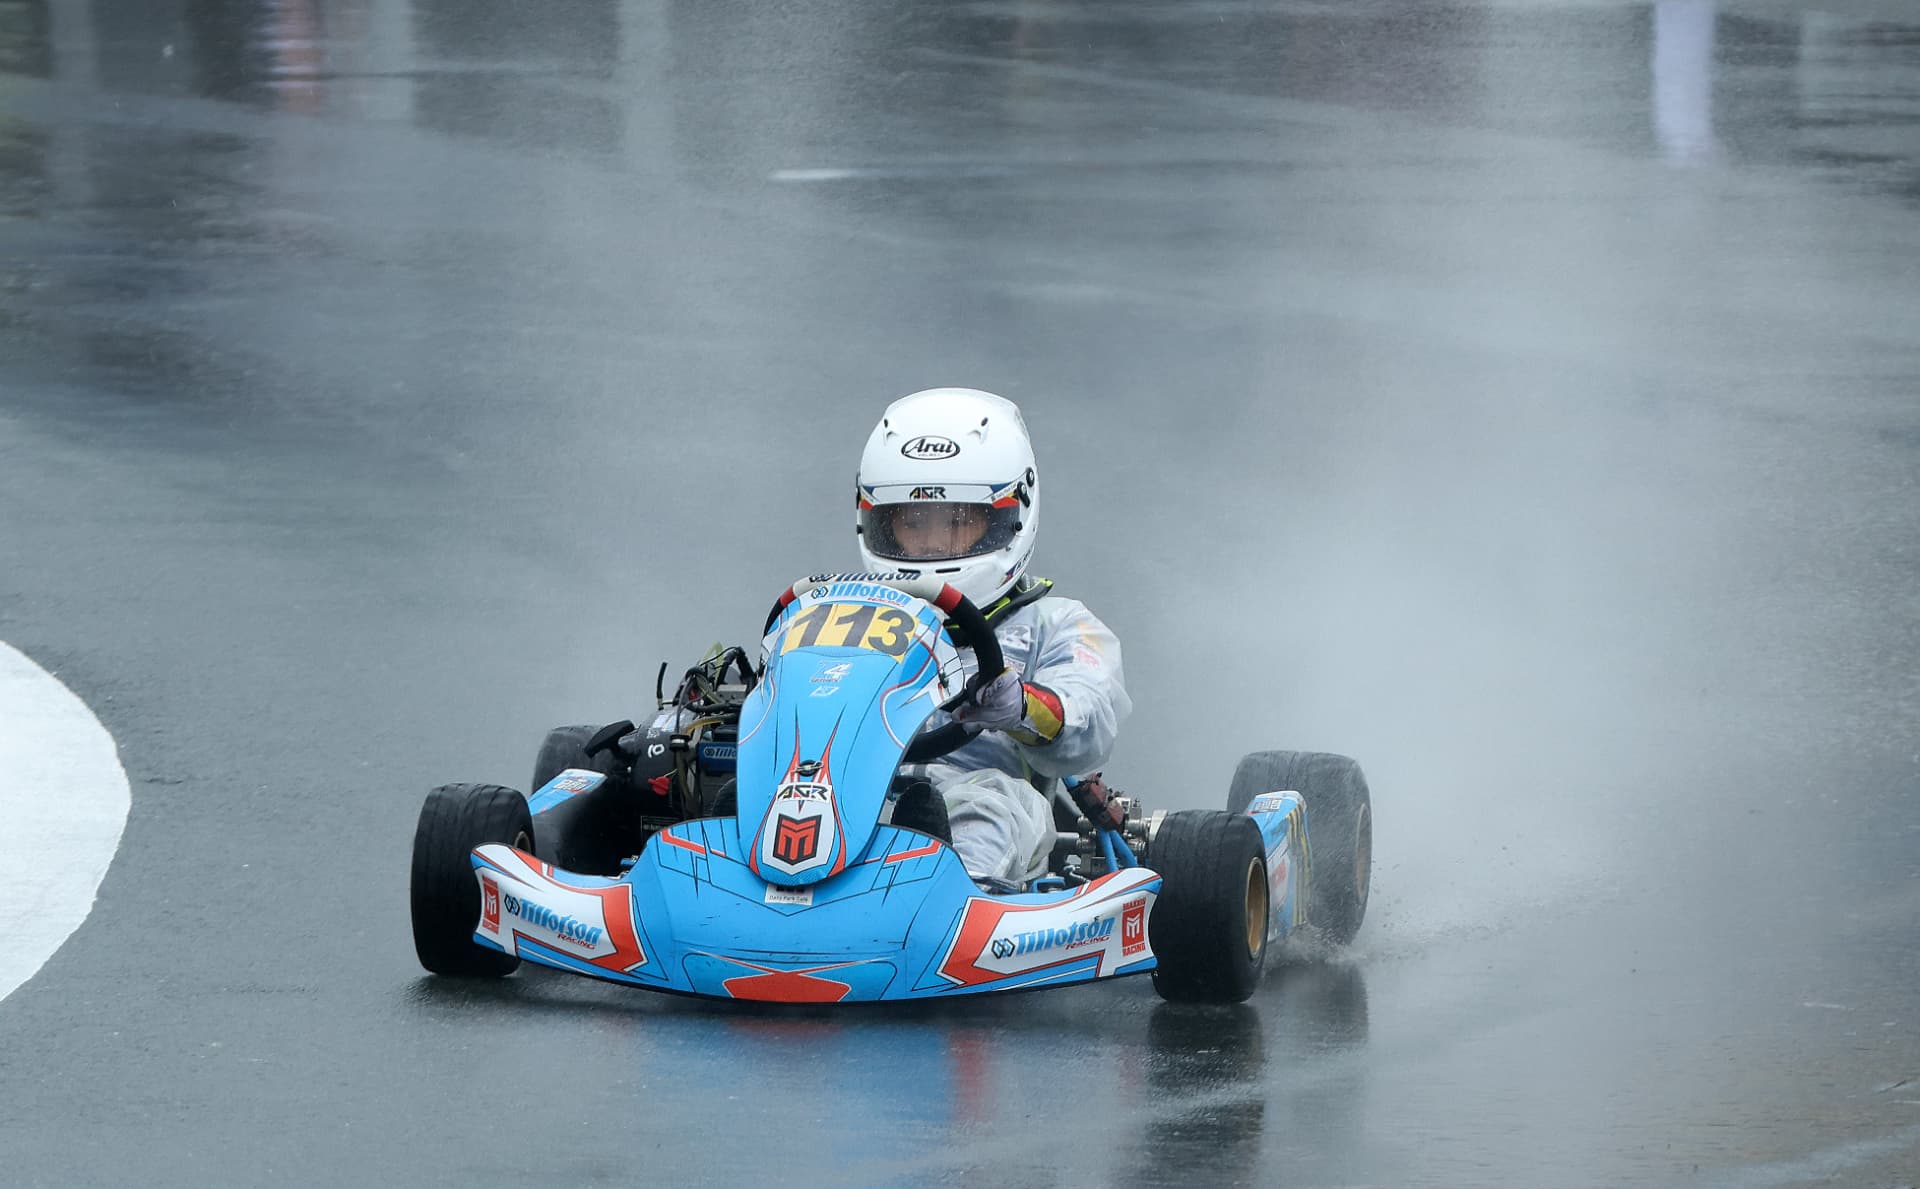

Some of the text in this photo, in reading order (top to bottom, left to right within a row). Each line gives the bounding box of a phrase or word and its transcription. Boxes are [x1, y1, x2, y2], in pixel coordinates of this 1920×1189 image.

[905, 438, 953, 453] Arai
[791, 603, 915, 657] 113
[520, 898, 603, 945] Tillotson
[557, 933, 596, 950] RACING
[1014, 917, 1116, 956] Tillotson
[1064, 935, 1111, 950] RACING
